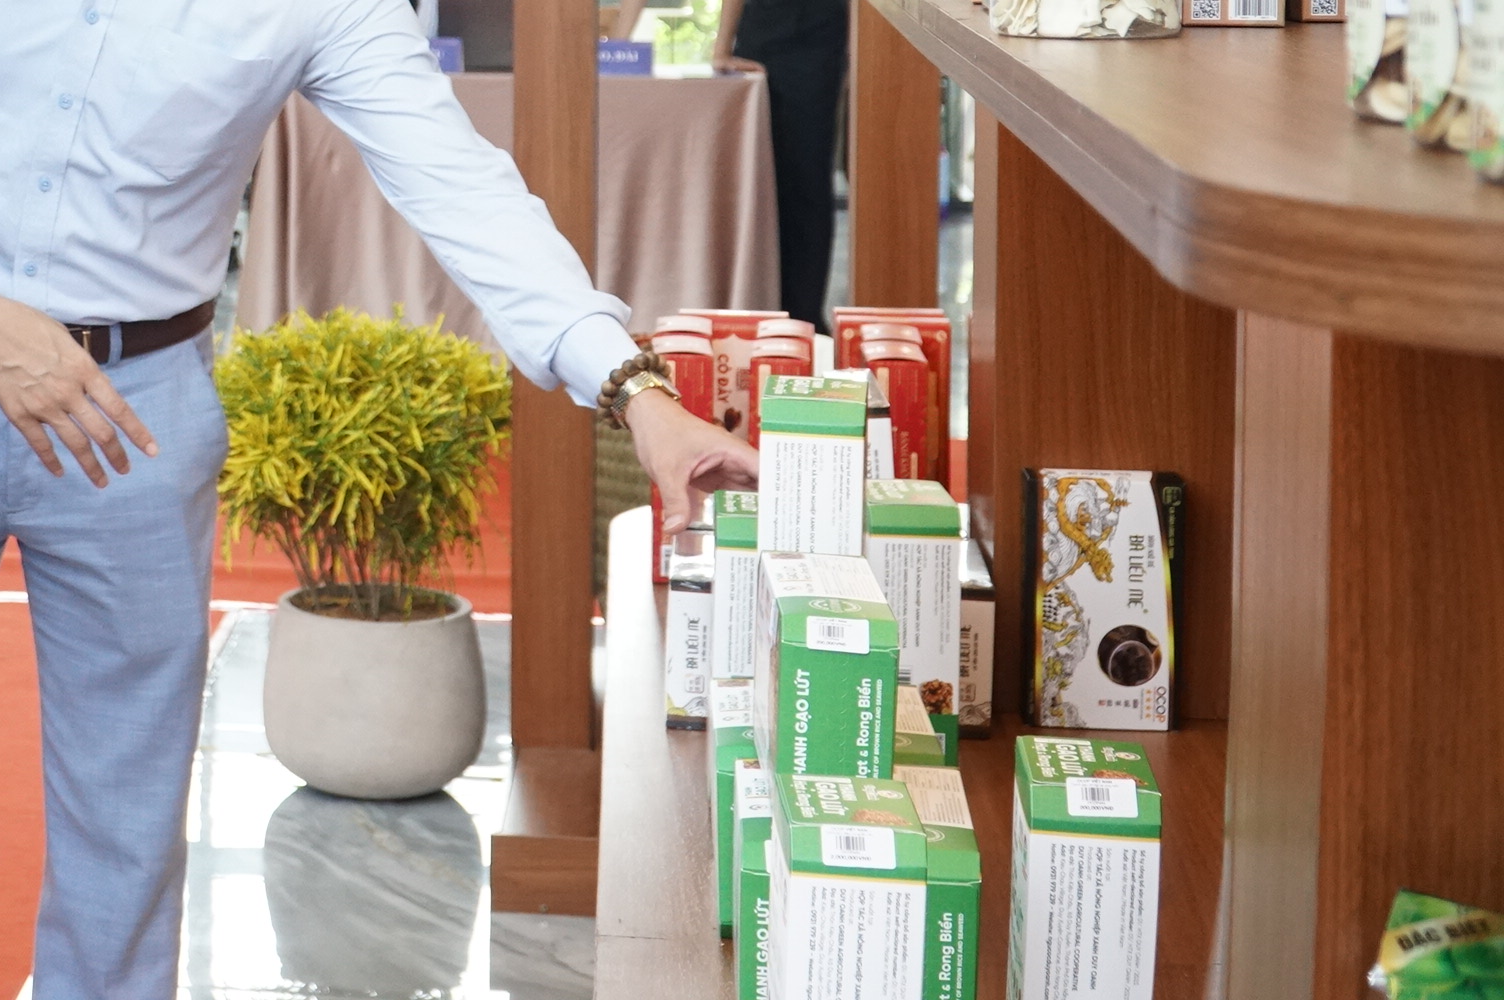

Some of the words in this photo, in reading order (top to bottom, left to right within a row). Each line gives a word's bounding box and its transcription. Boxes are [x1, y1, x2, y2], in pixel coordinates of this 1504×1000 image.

[1155, 686, 1167, 723] OCOP
[856, 711, 874, 747] Rong
[793, 736, 808, 775] HANH
[1076, 879, 1084, 901] GREEN
[1094, 888, 1103, 909] NÔNG
[938, 945, 956, 981] Rong
[1091, 955, 1099, 970] DUY
[755, 965, 770, 1000] ANH
